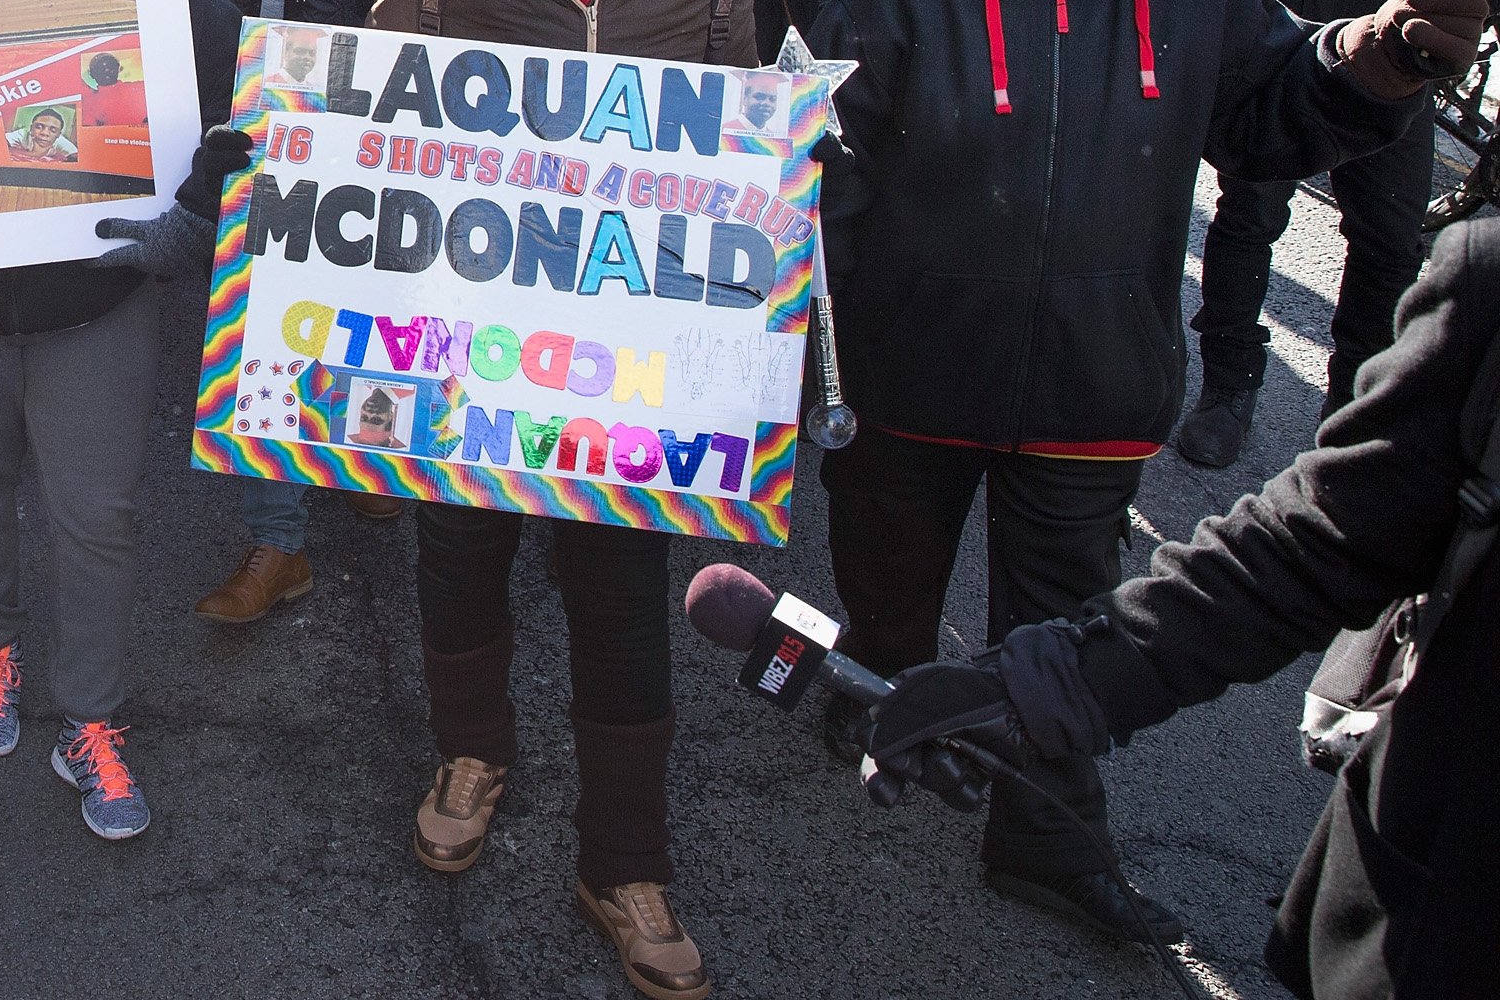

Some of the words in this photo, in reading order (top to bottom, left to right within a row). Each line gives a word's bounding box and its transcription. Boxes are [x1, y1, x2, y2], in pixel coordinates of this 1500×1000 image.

[326, 32, 726, 157] LAQUAN
[266, 124, 313, 165] 16
[356, 131, 503, 185] SHOTS
[505, 150, 589, 198] AND
[243, 172, 778, 310] MCDONALD
[280, 300, 666, 408] MCDONALD
[462, 404, 750, 494] LAQUAN
